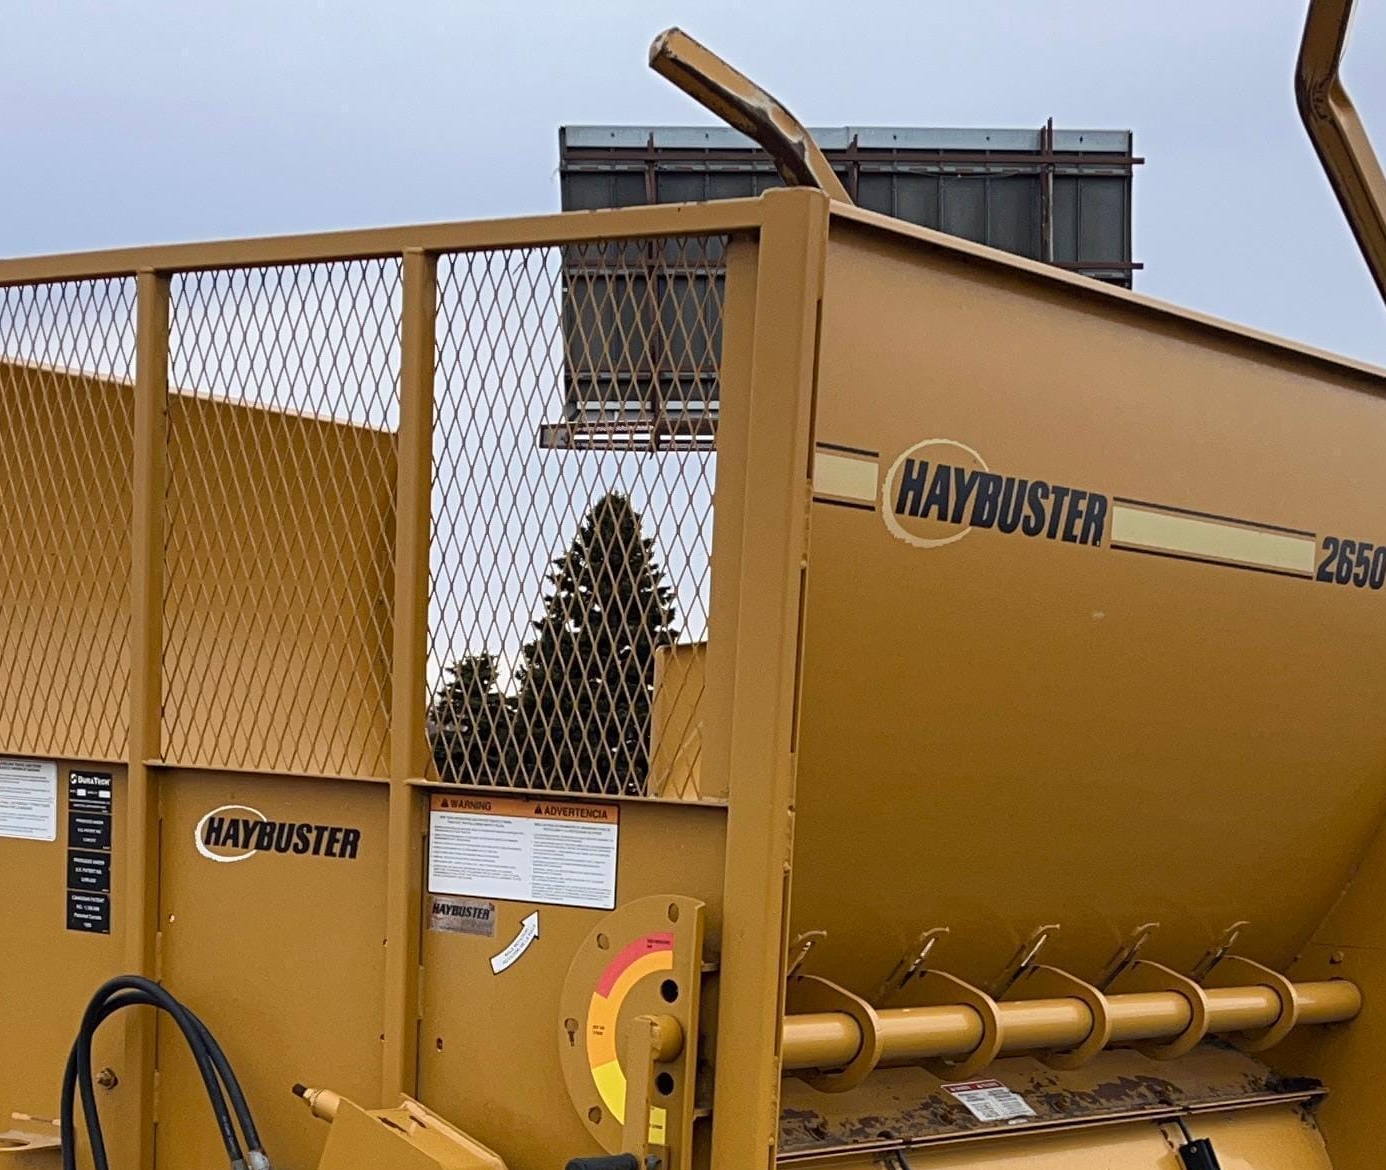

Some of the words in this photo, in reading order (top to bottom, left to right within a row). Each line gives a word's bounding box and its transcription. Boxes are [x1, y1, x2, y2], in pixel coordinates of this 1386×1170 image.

[895, 458, 1108, 547] HAYBUSTER
[450, 800, 492, 812] WARNING
[543, 805, 608, 820] ADVERTENCIA
[204, 816, 361, 860] HAYBUSTER
[432, 902, 491, 920] HAYBUSTER
